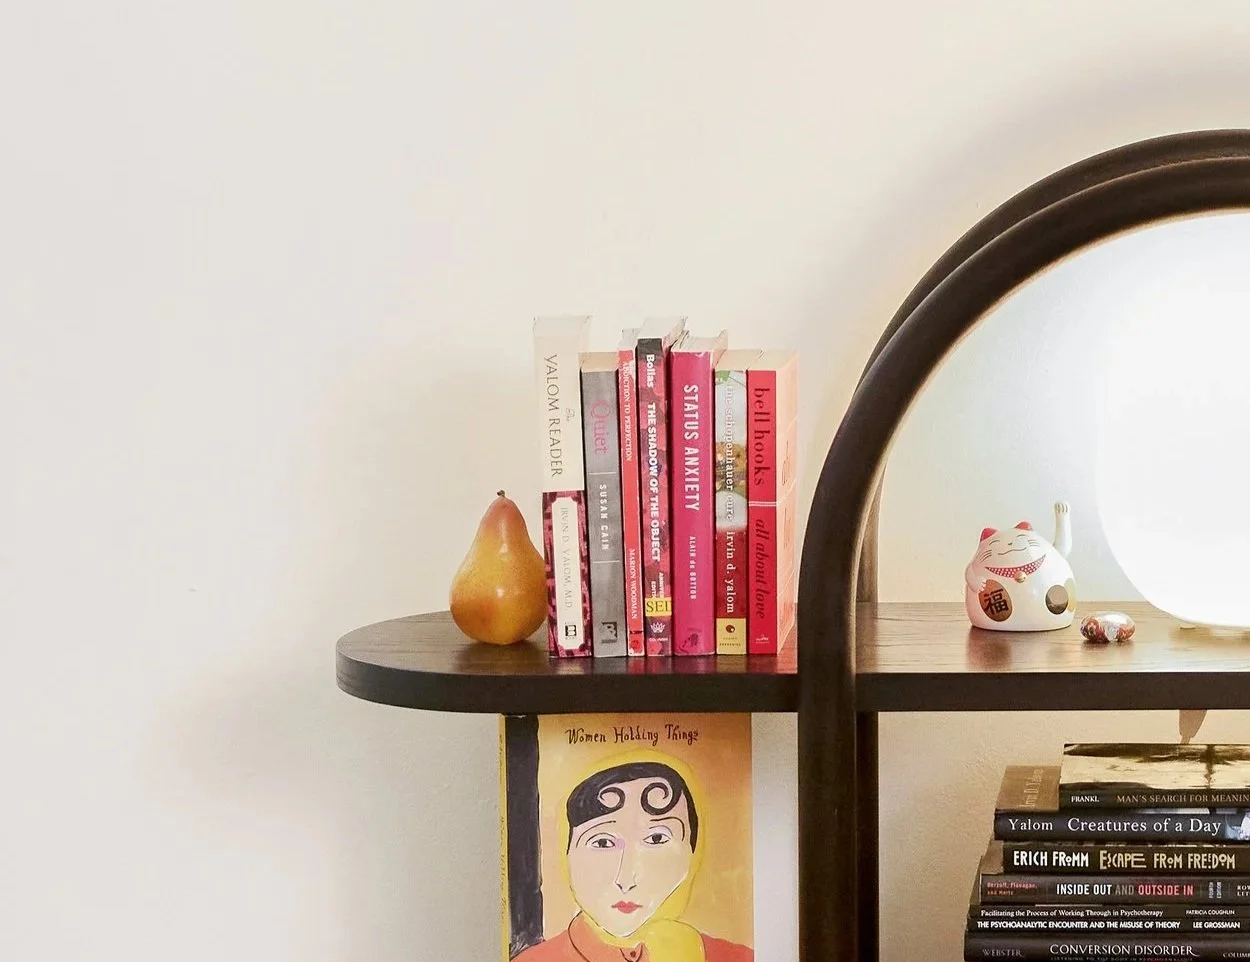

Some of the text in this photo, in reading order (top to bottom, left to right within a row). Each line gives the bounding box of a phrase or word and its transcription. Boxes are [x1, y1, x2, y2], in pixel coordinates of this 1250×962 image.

[549, 418, 563, 477] READER
[684, 384, 700, 511] STATUS ANXIETY
[754, 388, 771, 486] bell hooks
[647, 402, 660, 562] THE SHADOW OF THE OBJECT
[755, 519, 770, 541] all
[755, 543, 769, 584] about
[755, 588, 770, 619] love
[984, 588, 1009, 615] 福
[565, 724, 698, 746] Women Holding Things
[1009, 819, 1053, 830] Yalom
[1068, 818, 1221, 836] Creatures of a Day
[1057, 884, 1193, 895] INSIDE OUT AND OUTSIDE IN
[1120, 910, 1163, 918] Psychotherapy
[1050, 944, 1200, 957] CONVERSION DISORDER
